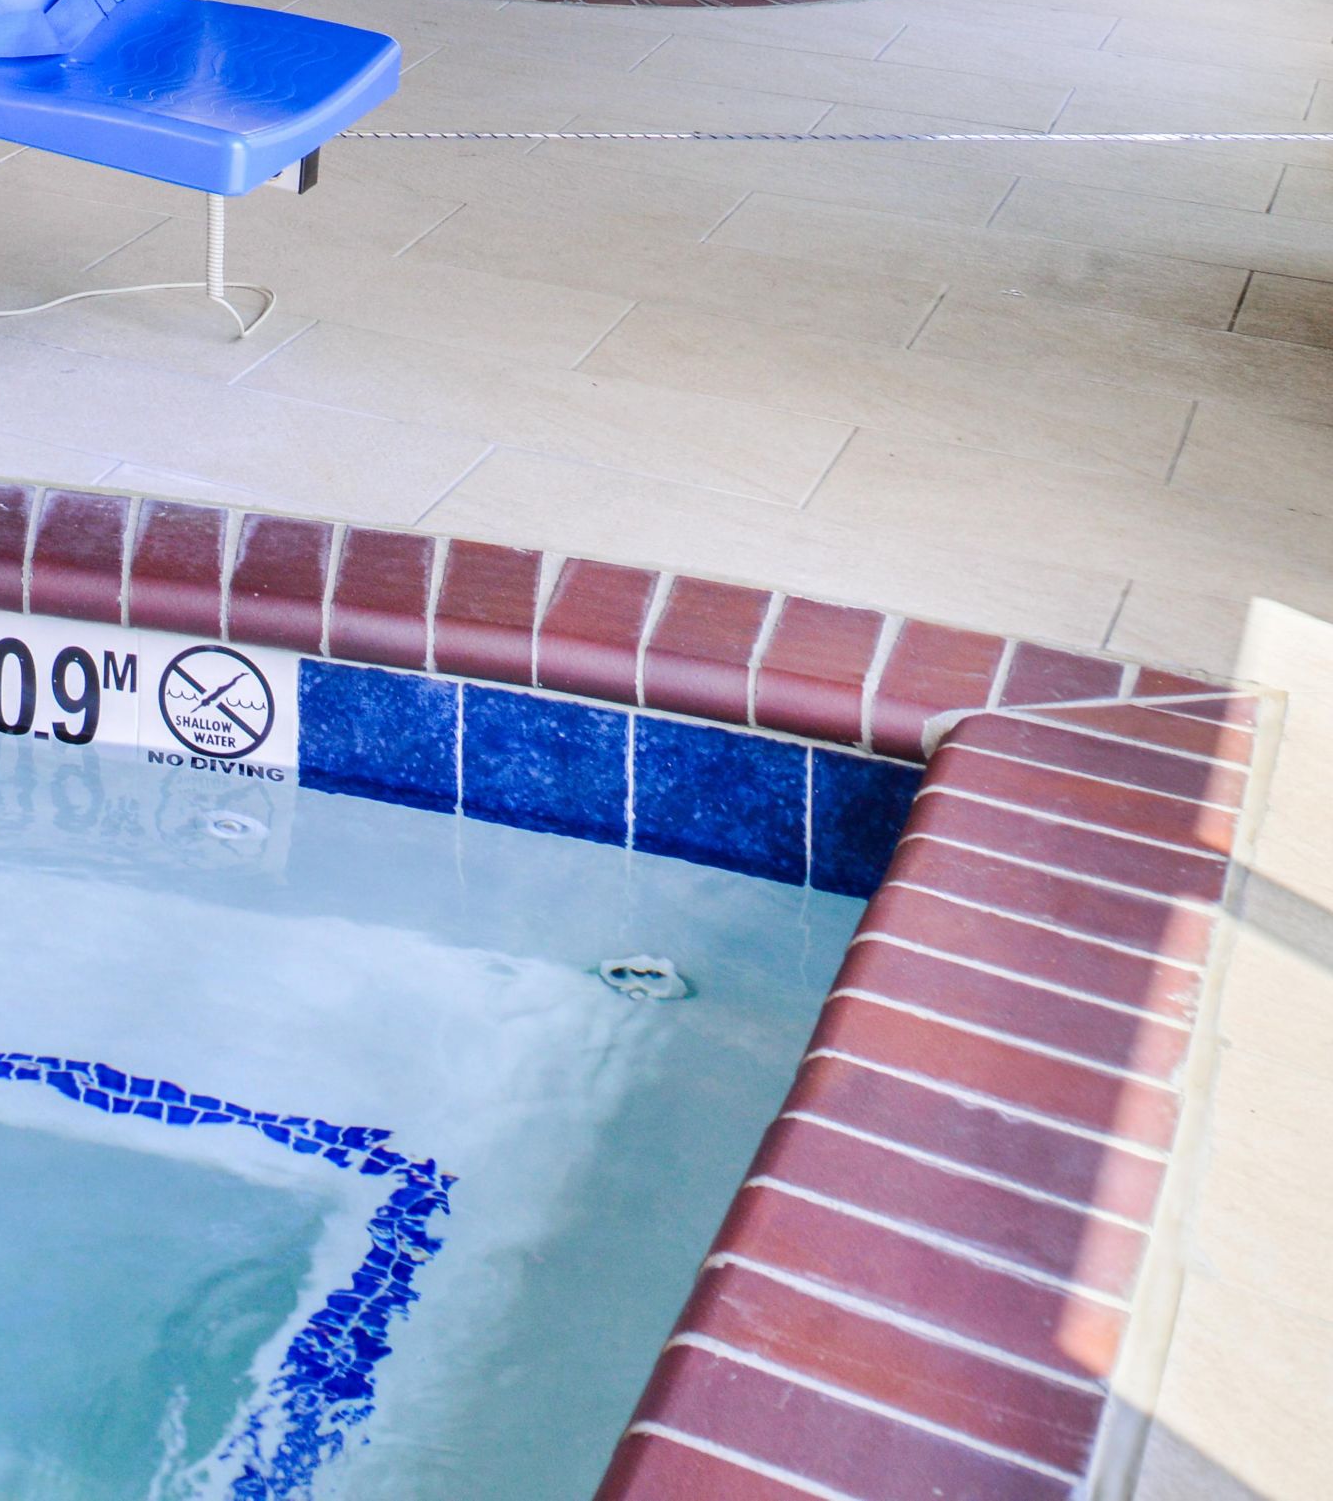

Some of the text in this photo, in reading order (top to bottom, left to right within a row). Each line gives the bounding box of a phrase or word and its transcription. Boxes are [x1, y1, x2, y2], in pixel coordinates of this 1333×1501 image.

[176, 715, 232, 733] SHALLOW
[194, 731, 236, 748] WATER
[148, 750, 285, 782] NO DIVING
